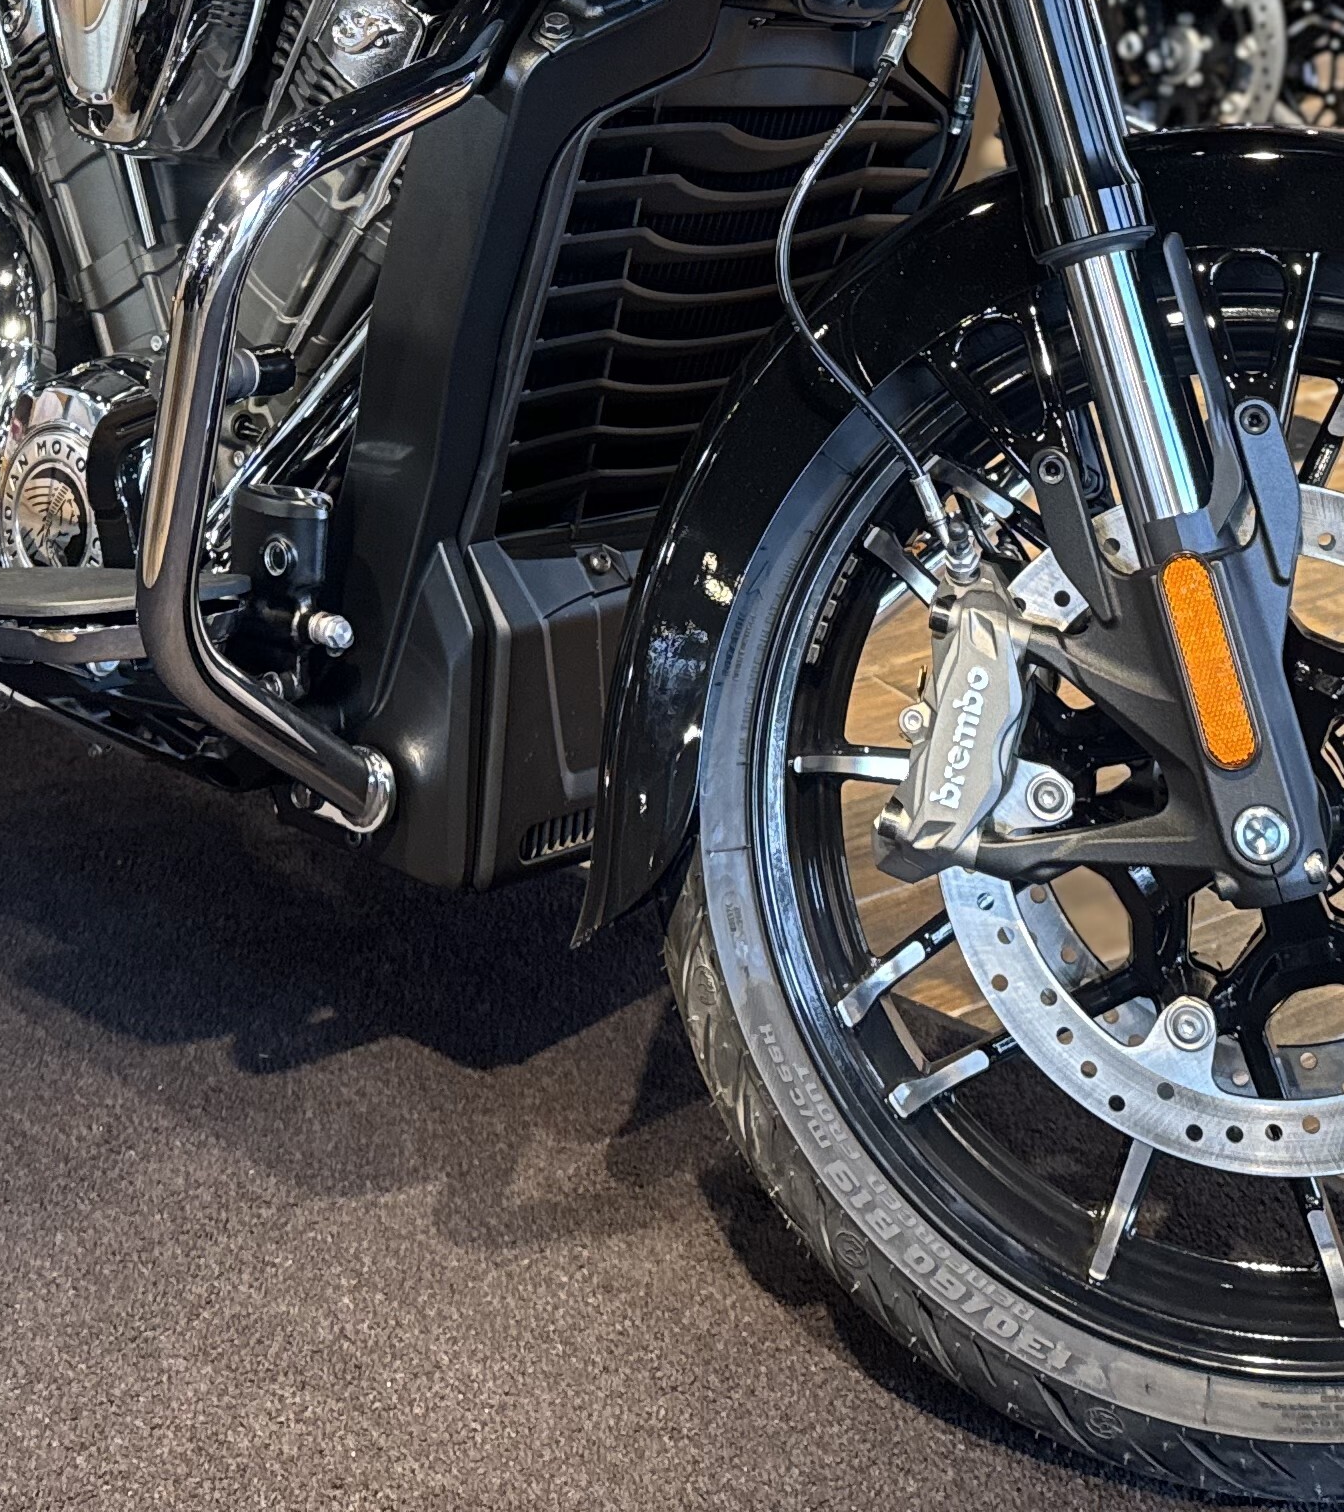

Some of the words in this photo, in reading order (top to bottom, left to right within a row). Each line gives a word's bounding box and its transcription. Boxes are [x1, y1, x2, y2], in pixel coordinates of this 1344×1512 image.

[930, 666, 989, 809] brembo
[822, 1158, 902, 1242] B19
[903, 1242, 1072, 1371] 130/60
